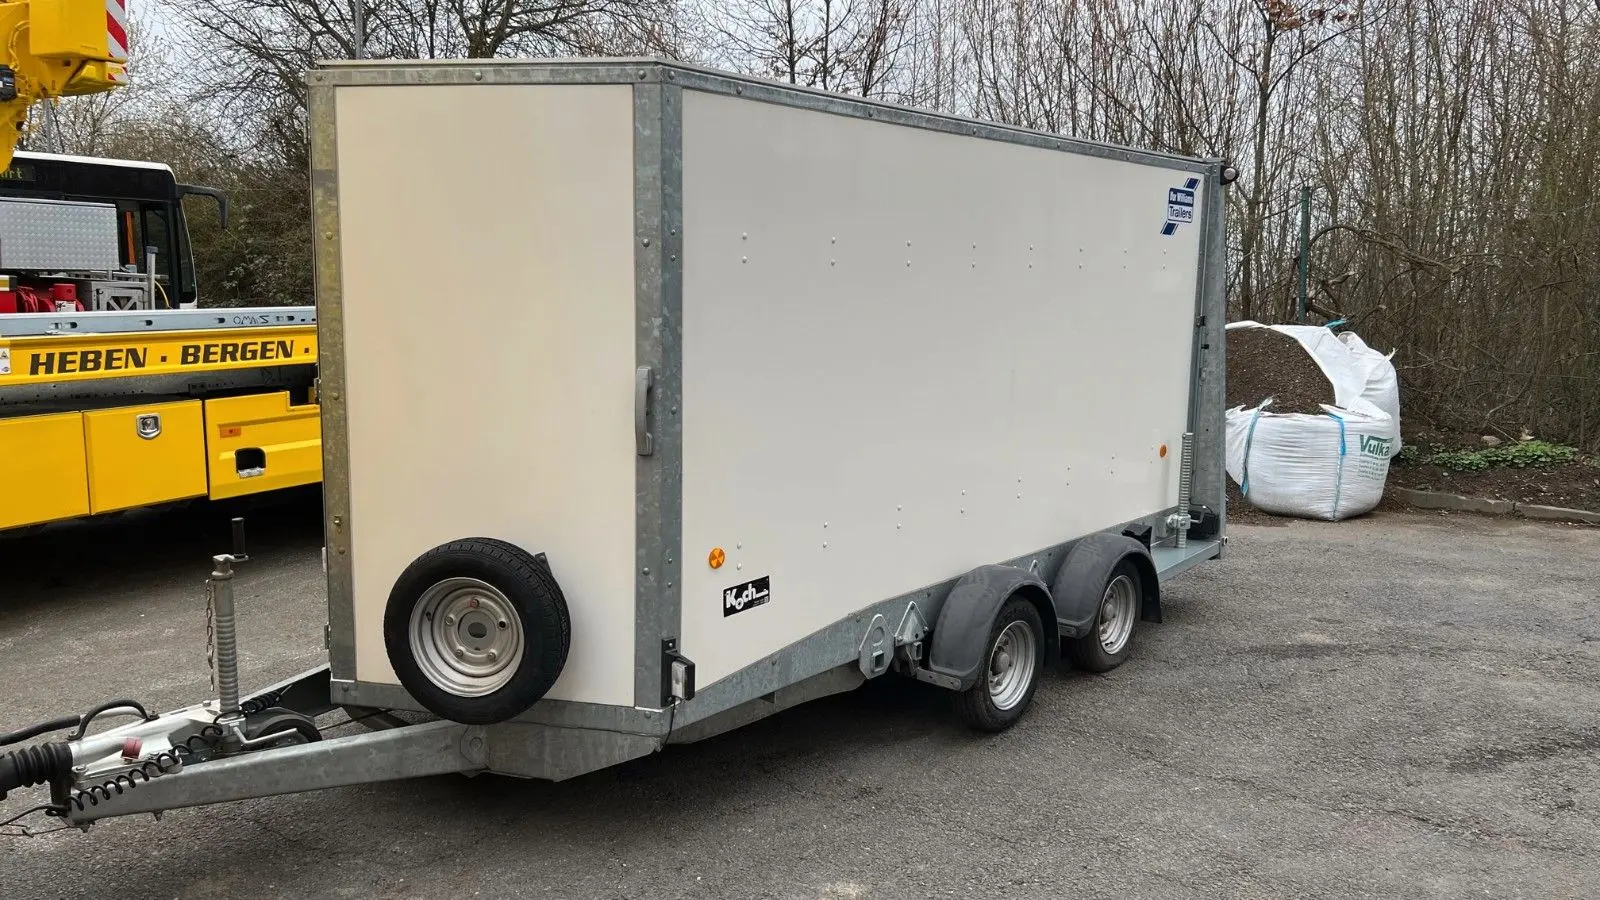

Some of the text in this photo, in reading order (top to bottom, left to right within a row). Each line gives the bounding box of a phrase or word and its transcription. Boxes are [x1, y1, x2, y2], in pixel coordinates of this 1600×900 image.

[1169, 205, 1192, 219] Trailers
[30, 340, 294, 375] HEBEN BERGEN
[726, 583, 757, 610] Koch
